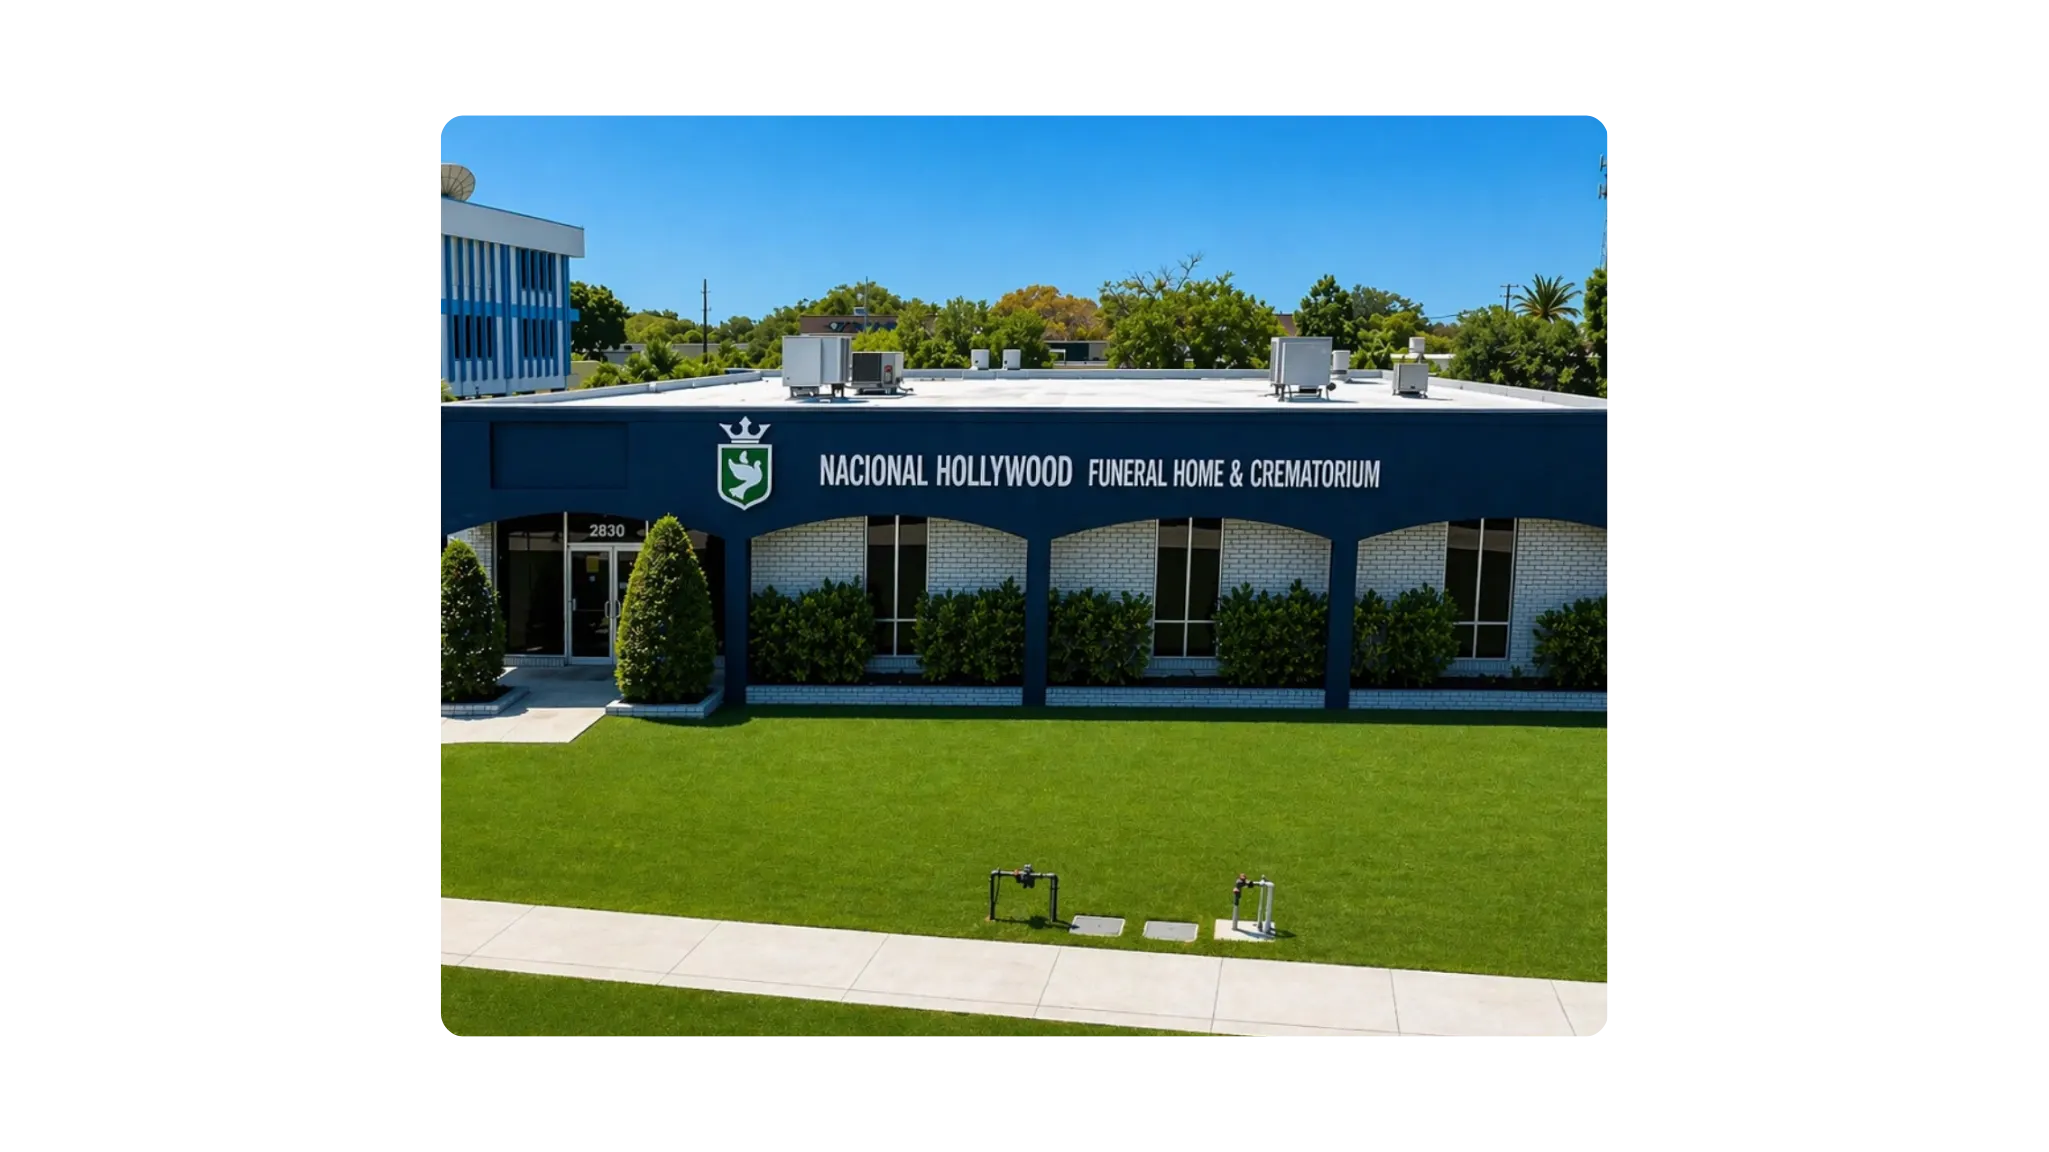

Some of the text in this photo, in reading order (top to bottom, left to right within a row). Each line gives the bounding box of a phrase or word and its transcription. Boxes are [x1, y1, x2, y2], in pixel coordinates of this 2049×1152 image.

[820, 454, 1381, 488] NACIONAL HOLLYWOOD FUNERAL HOME & CREMATORIUM
[589, 523, 625, 538] 2830
